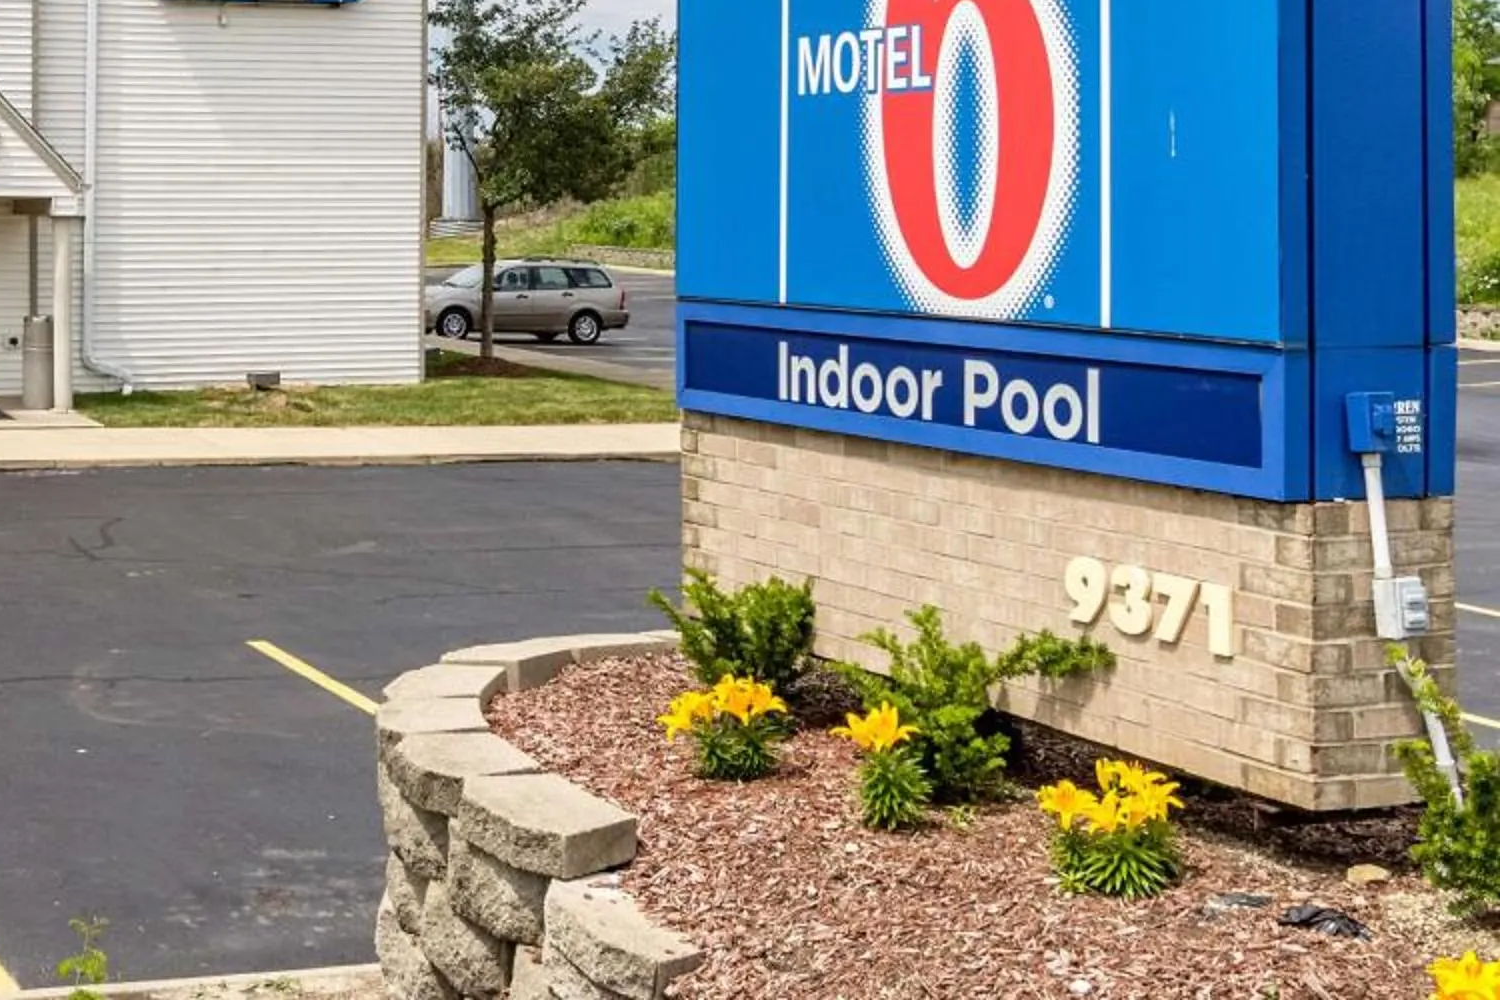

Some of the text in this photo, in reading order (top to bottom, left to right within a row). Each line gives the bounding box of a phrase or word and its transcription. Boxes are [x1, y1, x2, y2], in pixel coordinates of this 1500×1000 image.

[797, 24, 932, 96] MOTEL
[778, 341, 1100, 444] Indoor Pool
[1064, 556, 1234, 657] 9371
